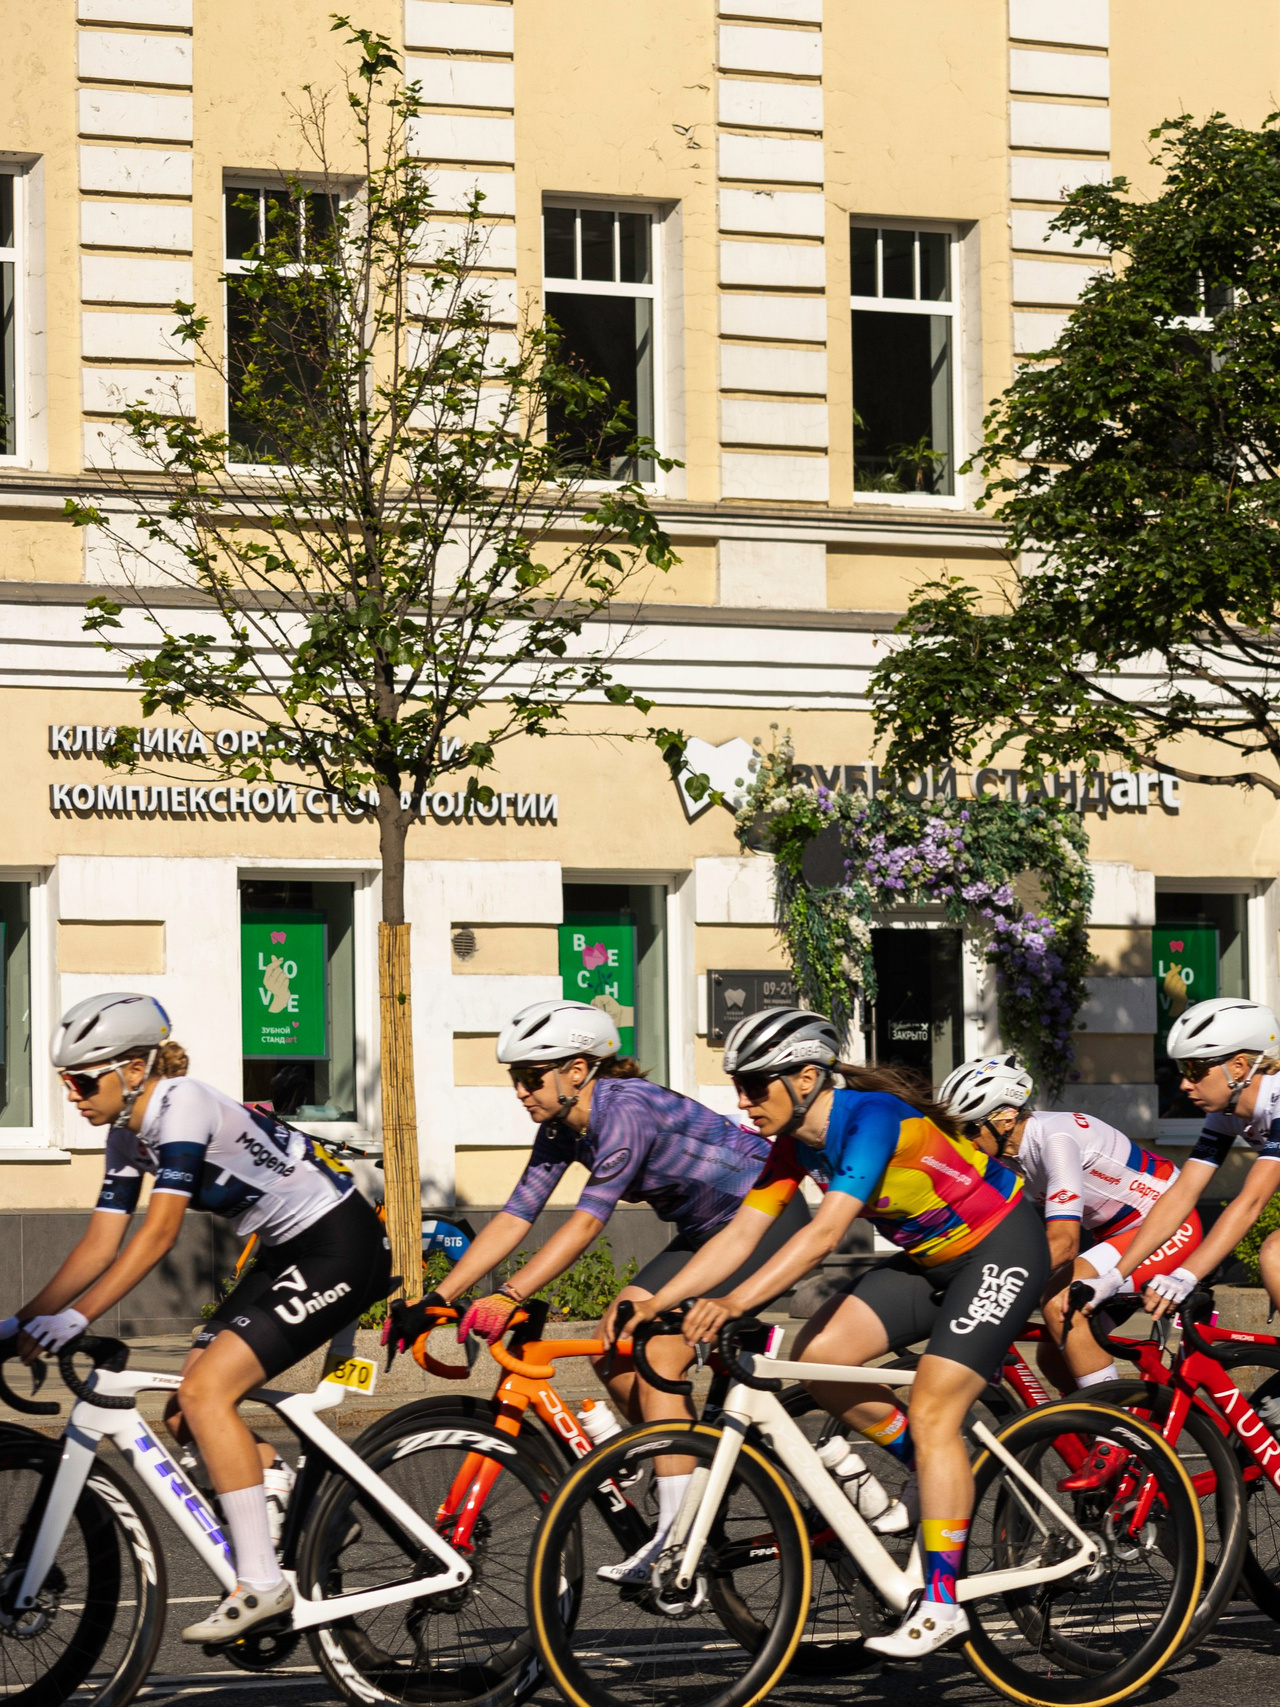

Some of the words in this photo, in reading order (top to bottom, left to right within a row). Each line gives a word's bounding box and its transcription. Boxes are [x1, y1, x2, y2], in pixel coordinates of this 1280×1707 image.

[51, 725, 209, 754] КЛИИКА
[51, 782, 297, 815] КОМПЛЕКСНОЙ
[261, 1026, 291, 1034] ЗУБНОЙ
[261, 1035, 298, 1044] СТАНДart
[892, 1030, 929, 1041] ЗАКРЫТО
[792, 1046, 820, 1058] 1084
[1004, 1087, 1024, 1101] 1065
[235, 1131, 295, 1177] Magene
[163, 1168, 194, 1183] Bera
[920, 1154, 973, 1187] classteam.pro
[444, 1236, 463, 1248] ВТБ
[274, 1281, 352, 1325] Union
[334, 1360, 370, 1385] 870
[391, 1429, 518, 1460] ZIPP
[1111, 1425, 1153, 1451] PRO
[86, 1474, 157, 1585] ZIPP
[749, 1546, 780, 1558] PINA
